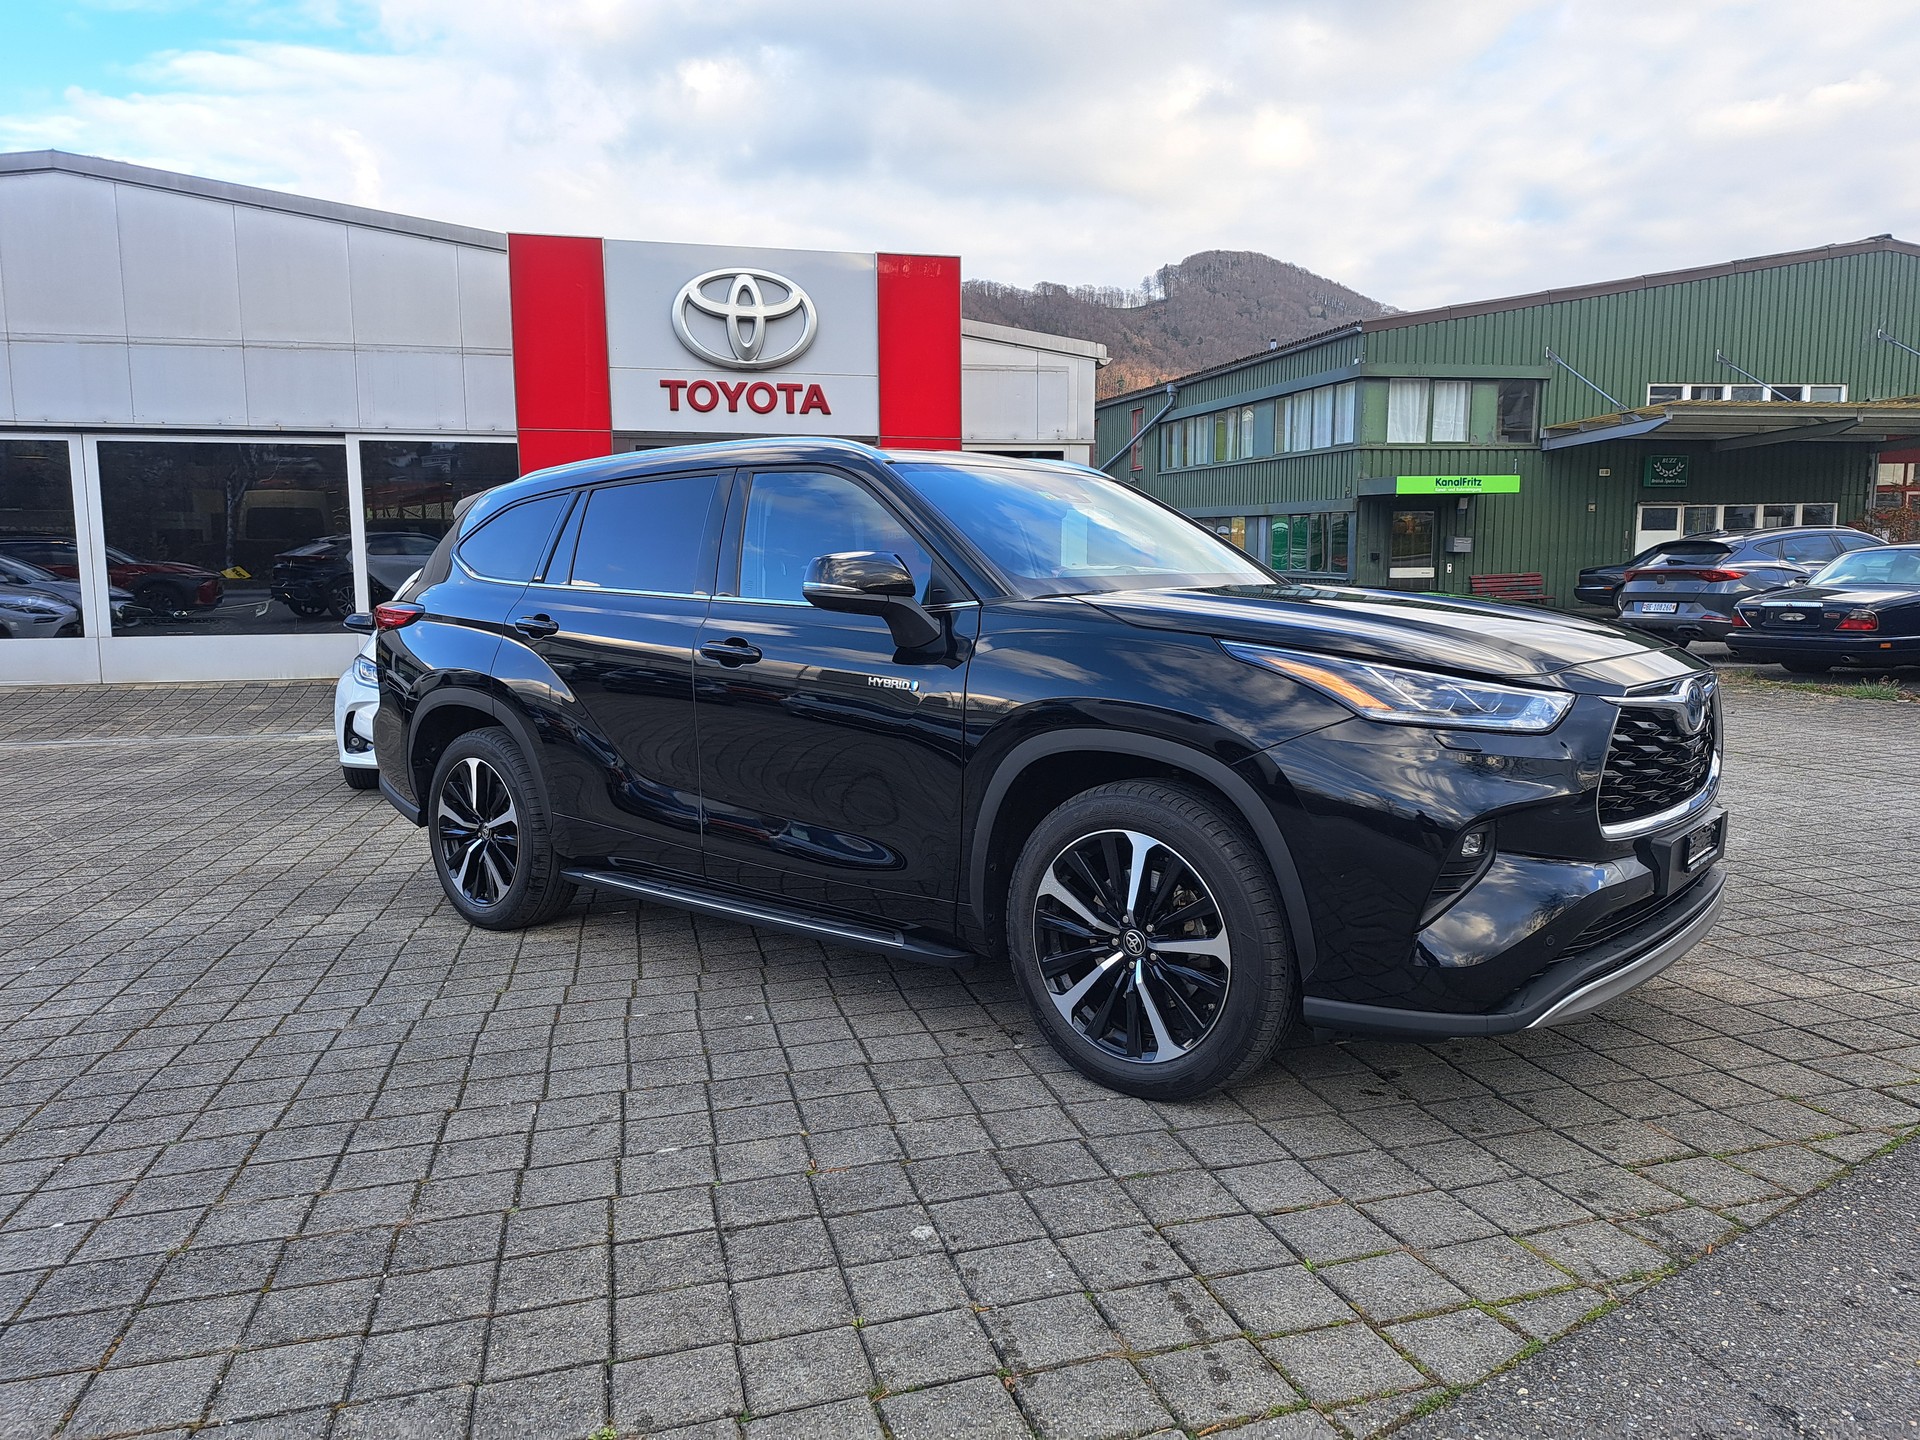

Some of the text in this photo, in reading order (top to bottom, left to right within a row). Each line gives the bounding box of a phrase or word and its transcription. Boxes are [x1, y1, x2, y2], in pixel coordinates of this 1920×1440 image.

[660, 379, 832, 415] TOYOTA
[1435, 477, 1482, 487] KanalFritz
[868, 676, 911, 691] HYBRID
